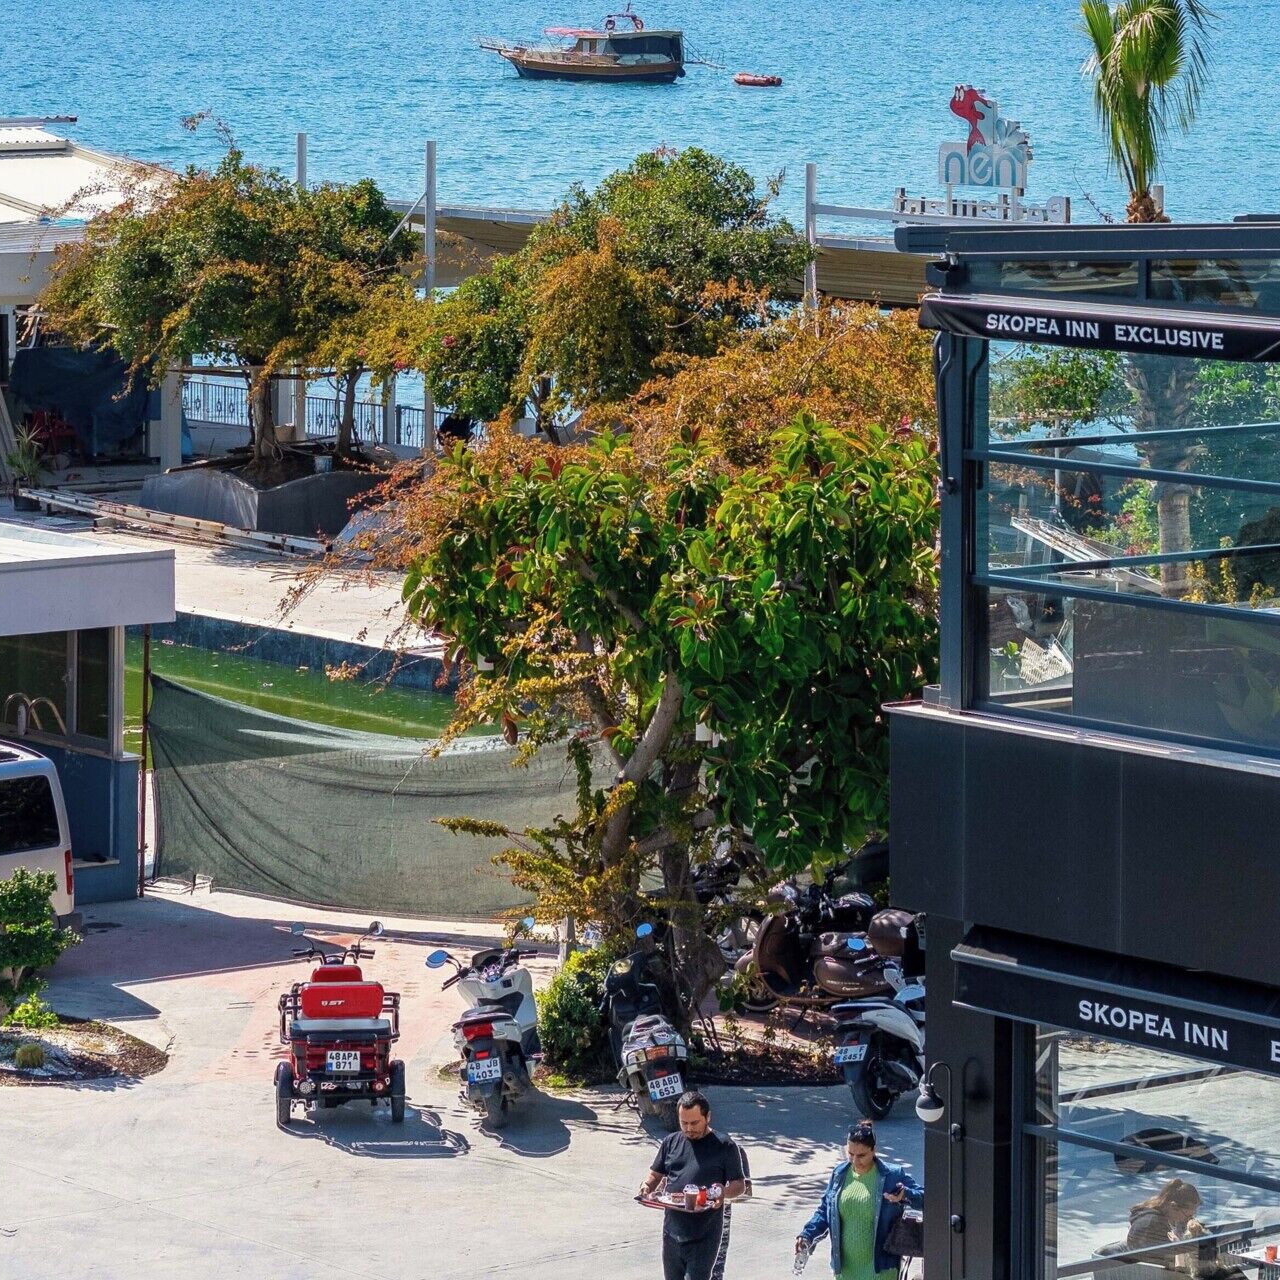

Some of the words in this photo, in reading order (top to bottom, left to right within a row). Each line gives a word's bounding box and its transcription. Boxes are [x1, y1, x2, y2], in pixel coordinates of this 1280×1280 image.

[986, 313, 1060, 335] SKOPEA
[1066, 320, 1099, 339] INN
[1115, 324, 1224, 349] EXCLUSIVE
[1079, 1000, 1176, 1039] SKOPEA
[1184, 1021, 1229, 1051] INN
[329, 1052, 341, 1061] 48
[342, 1052, 359, 1061] APA
[335, 1061, 352, 1070] 871
[469, 1063, 481, 1071] 48
[475, 1069, 493, 1080] 403
[649, 1080, 661, 1090] 48
[658, 1086, 676, 1097] 653
